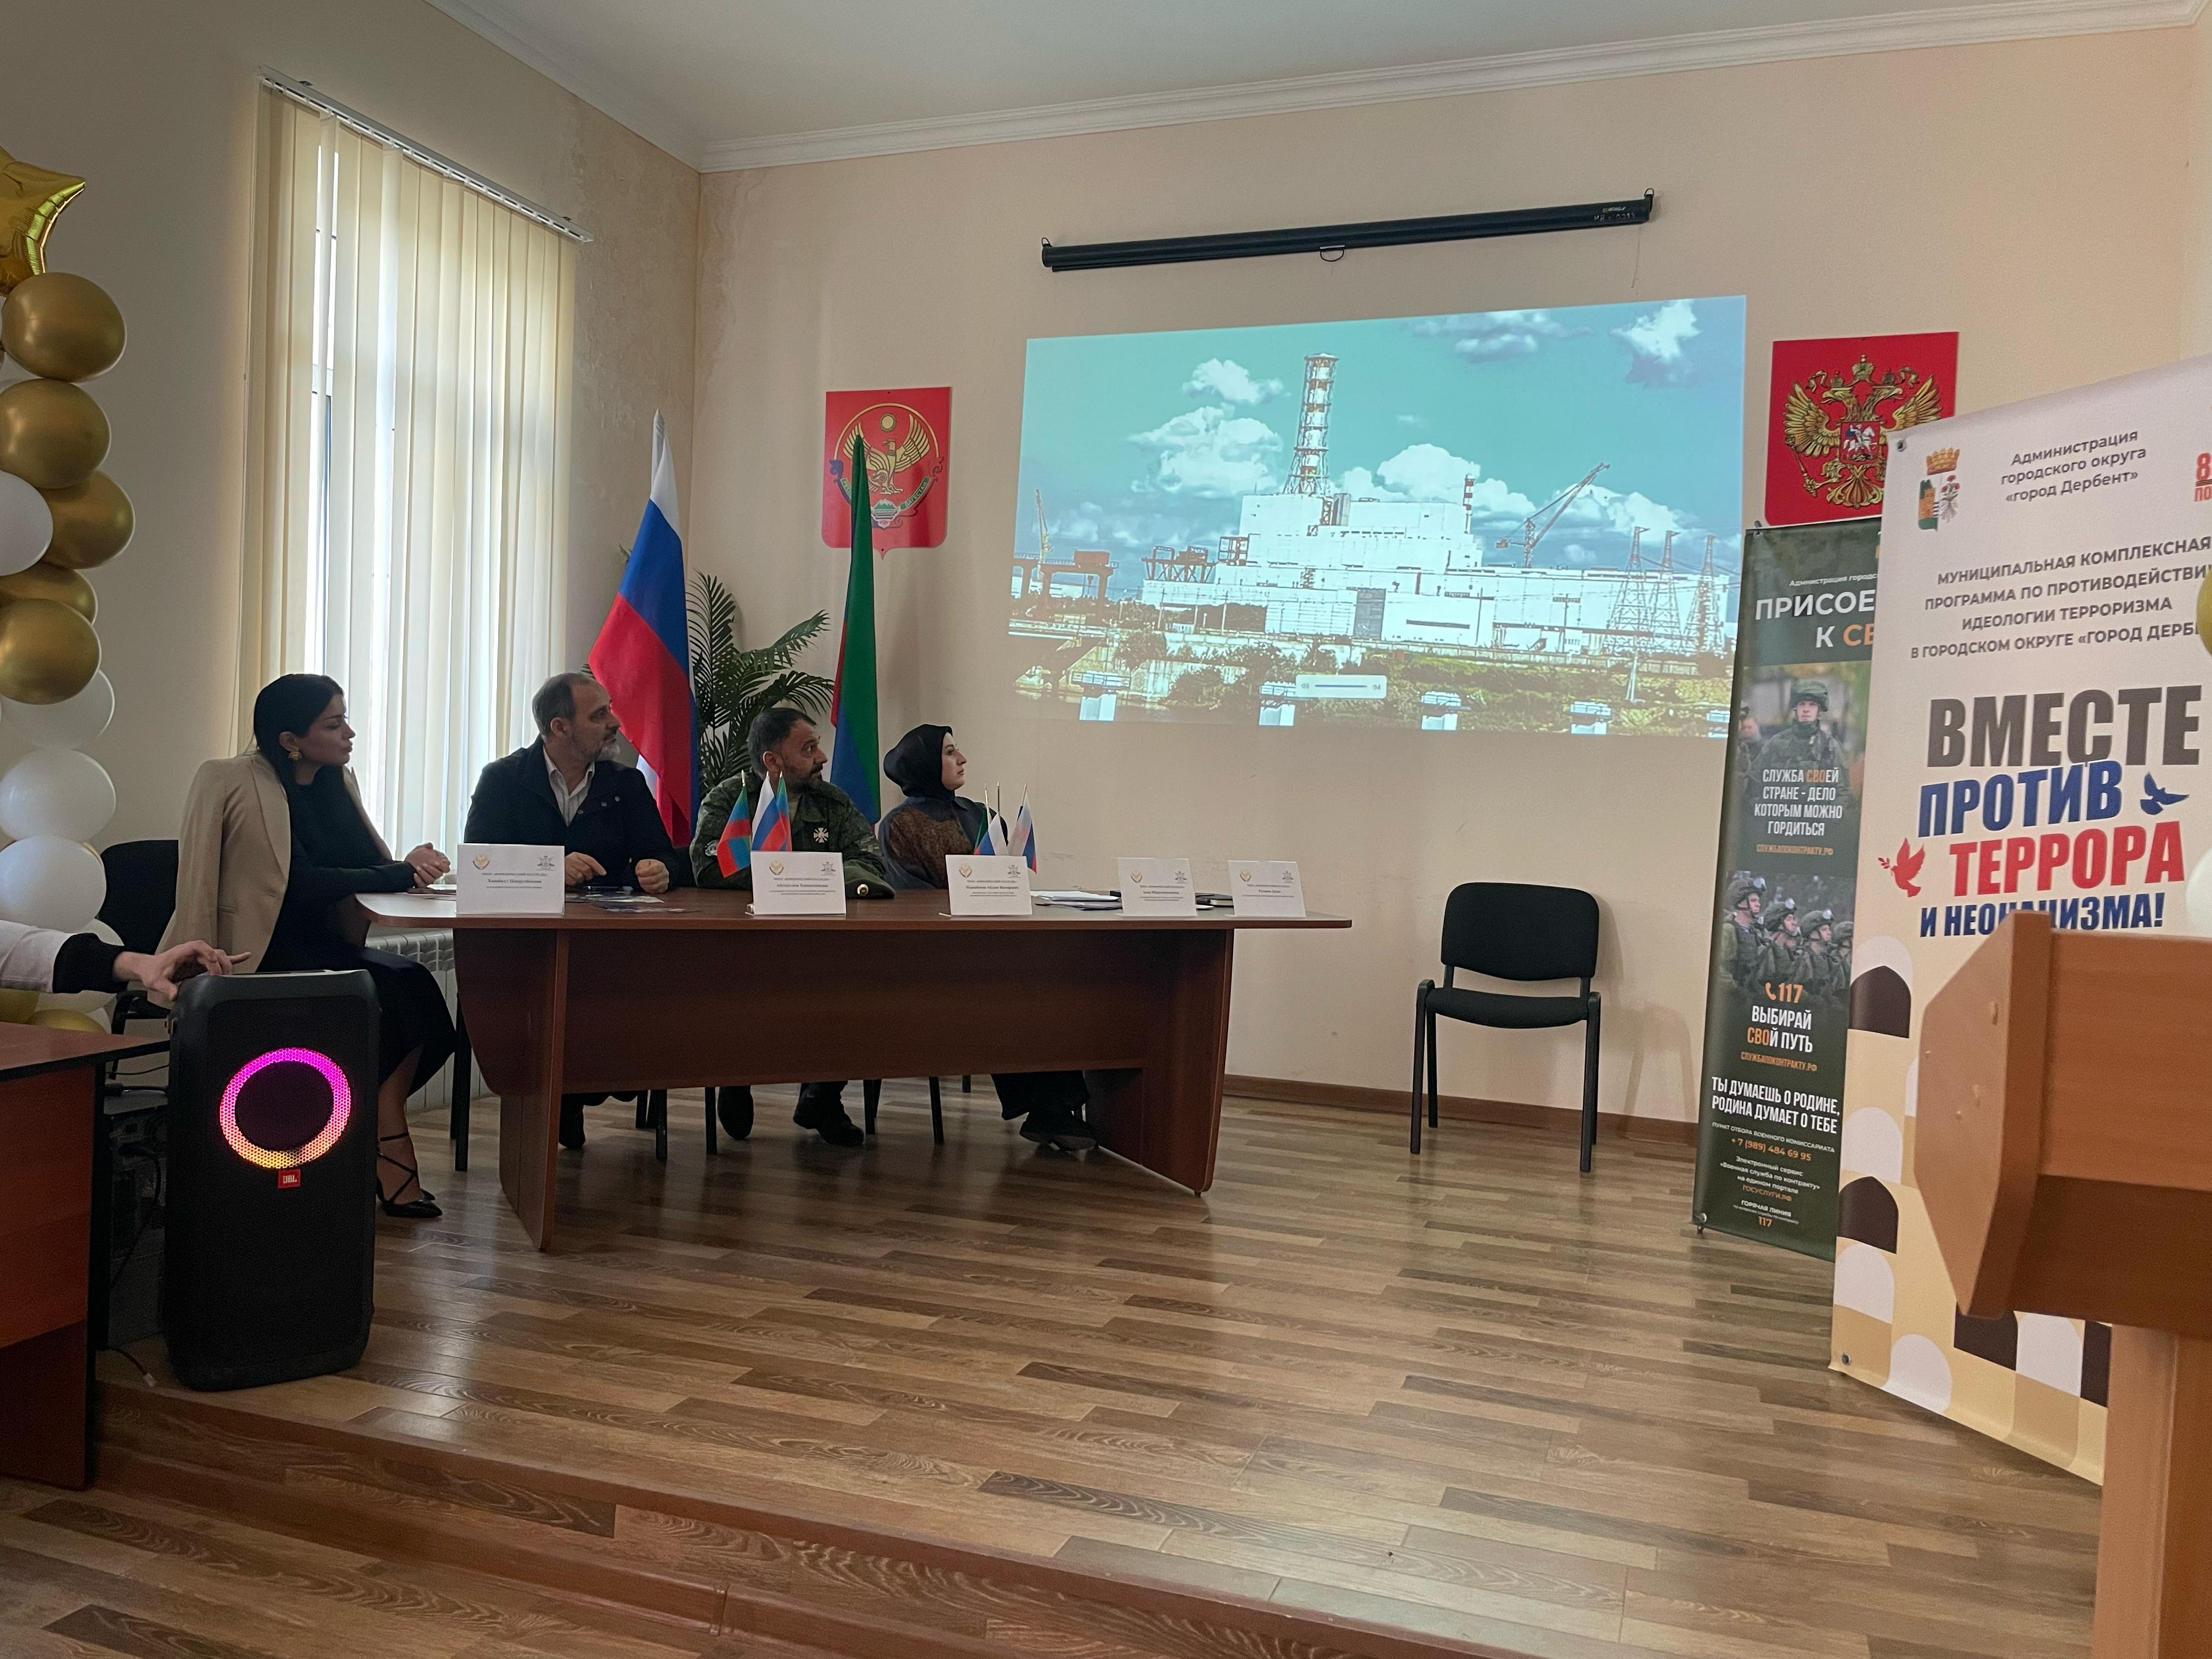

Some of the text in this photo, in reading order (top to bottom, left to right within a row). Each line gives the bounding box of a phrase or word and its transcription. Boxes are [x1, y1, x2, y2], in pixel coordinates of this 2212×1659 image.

[2011, 431, 2138, 466] Администрация
[2001, 447, 2146, 485] городского округа
[2005, 471, 2138, 503] «город Дербент»
[1938, 536, 2211, 585] МУНИЦИПАЛЬНАЯ КОМПЛЕКСНАЯ
[1789, 576, 1848, 586] Администрация
[1925, 564, 2212, 610] ПРОГРАММА ПО ПРОТИВОДЕЙСТВИ
[1756, 589, 1876, 620] ПРИСОЕ
[1962, 597, 2172, 631] ИДЕОЛОГИИ ТЕРРОРИЗМА
[1816, 626, 1835, 648] К
[1911, 647, 1919, 659] В
[1922, 638, 2010, 659] ГОРОДСКОМ
[2015, 633, 2074, 650] ОКРУГЕ
[2078, 627, 2142, 643] «ГОРОД
[1927, 685, 2202, 768] ВМЕСТЕ
[1763, 767, 1838, 783] СЛУЖБА СВОЕЙ
[1763, 787, 1799, 800] СТРАНЕ
[1807, 787, 1836, 802] ДЕЛО
[1918, 760, 2123, 838] ПРОТИВ
[1754, 803, 1842, 819] КОТОРЫМ МОЖНО
[1768, 821, 1825, 836] ГОРДИТЬСЯ
[1949, 820, 2185, 896] ТЕРРОРА
[1920, 893, 2166, 938] И НЕОИЗМА!
[1778, 983, 1804, 1003] 117
[1752, 1005, 1812, 1030] ВЫБИРАЙ
[1747, 1027, 1813, 1053] СВОЙ ПУТЬ
[1712, 1076, 1840, 1116] ТЫ ДУМАЕШЬ О РОДИНЕ,
[1712, 1095, 1837, 1135] РОДИНА ДУМАЕТ О ТЕБЕ
[1730, 1126, 1753, 1135] ОТБОРА
[1753, 1131, 1785, 1142] ВОЕННОГО
[1786, 1138, 1835, 1153] КОМИССАРИАТА
[1736, 1155, 1803, 1176] Электронный сервис
[1787, 1149, 1798, 1158] 69
[1800, 1152, 1812, 1161] 95
[283, 1175, 297, 1183] JBL
[1746, 1178, 1771, 1187] едином
[1772, 1183, 1798, 1194] портале
[1750, 1169, 1773, 1178] служба
[1741, 1200, 1768, 1211] ГОРЯЧАЯ
[1769, 1207, 1791, 1217] ЛИНИЯ
[1758, 1216, 1772, 1227] 117
